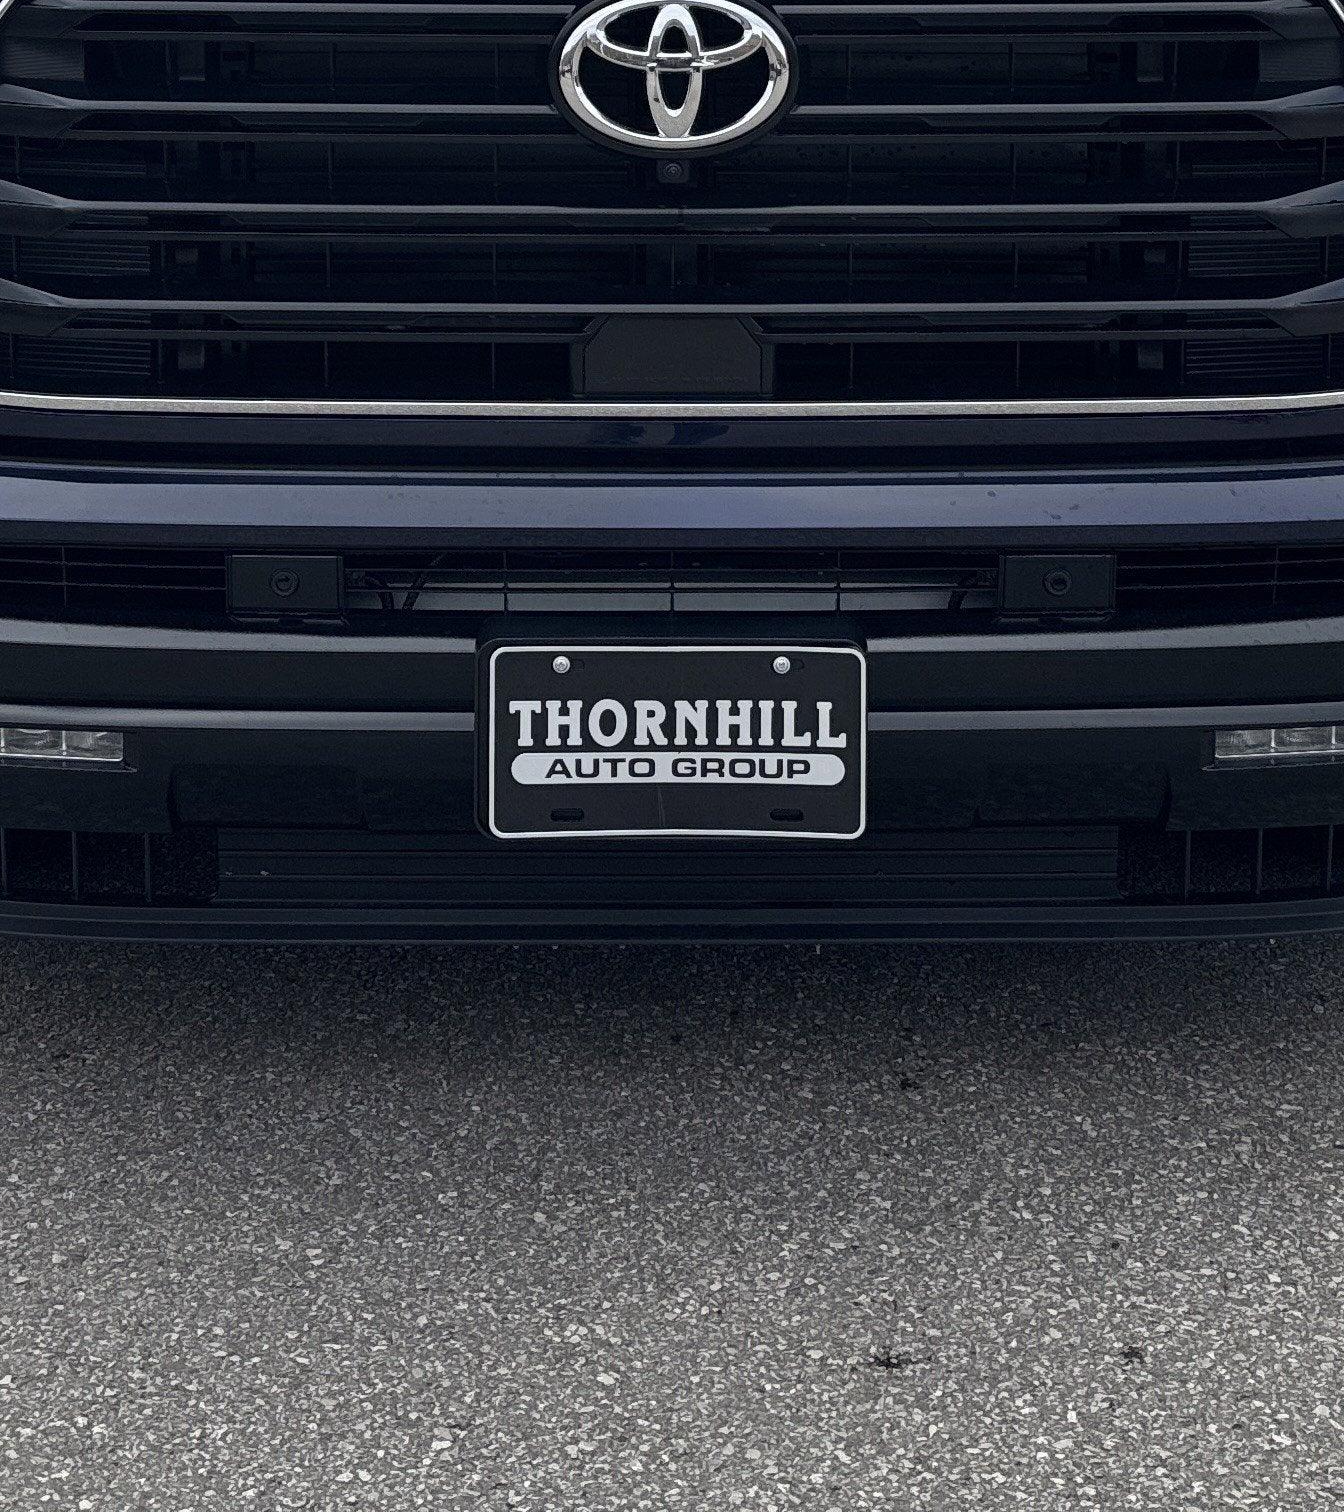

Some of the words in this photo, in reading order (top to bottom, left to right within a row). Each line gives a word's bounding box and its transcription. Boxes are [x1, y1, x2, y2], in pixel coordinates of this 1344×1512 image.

[508, 698, 847, 748] THORNHILL
[545, 758, 656, 779] AUTO
[671, 757, 811, 779] GROUP
